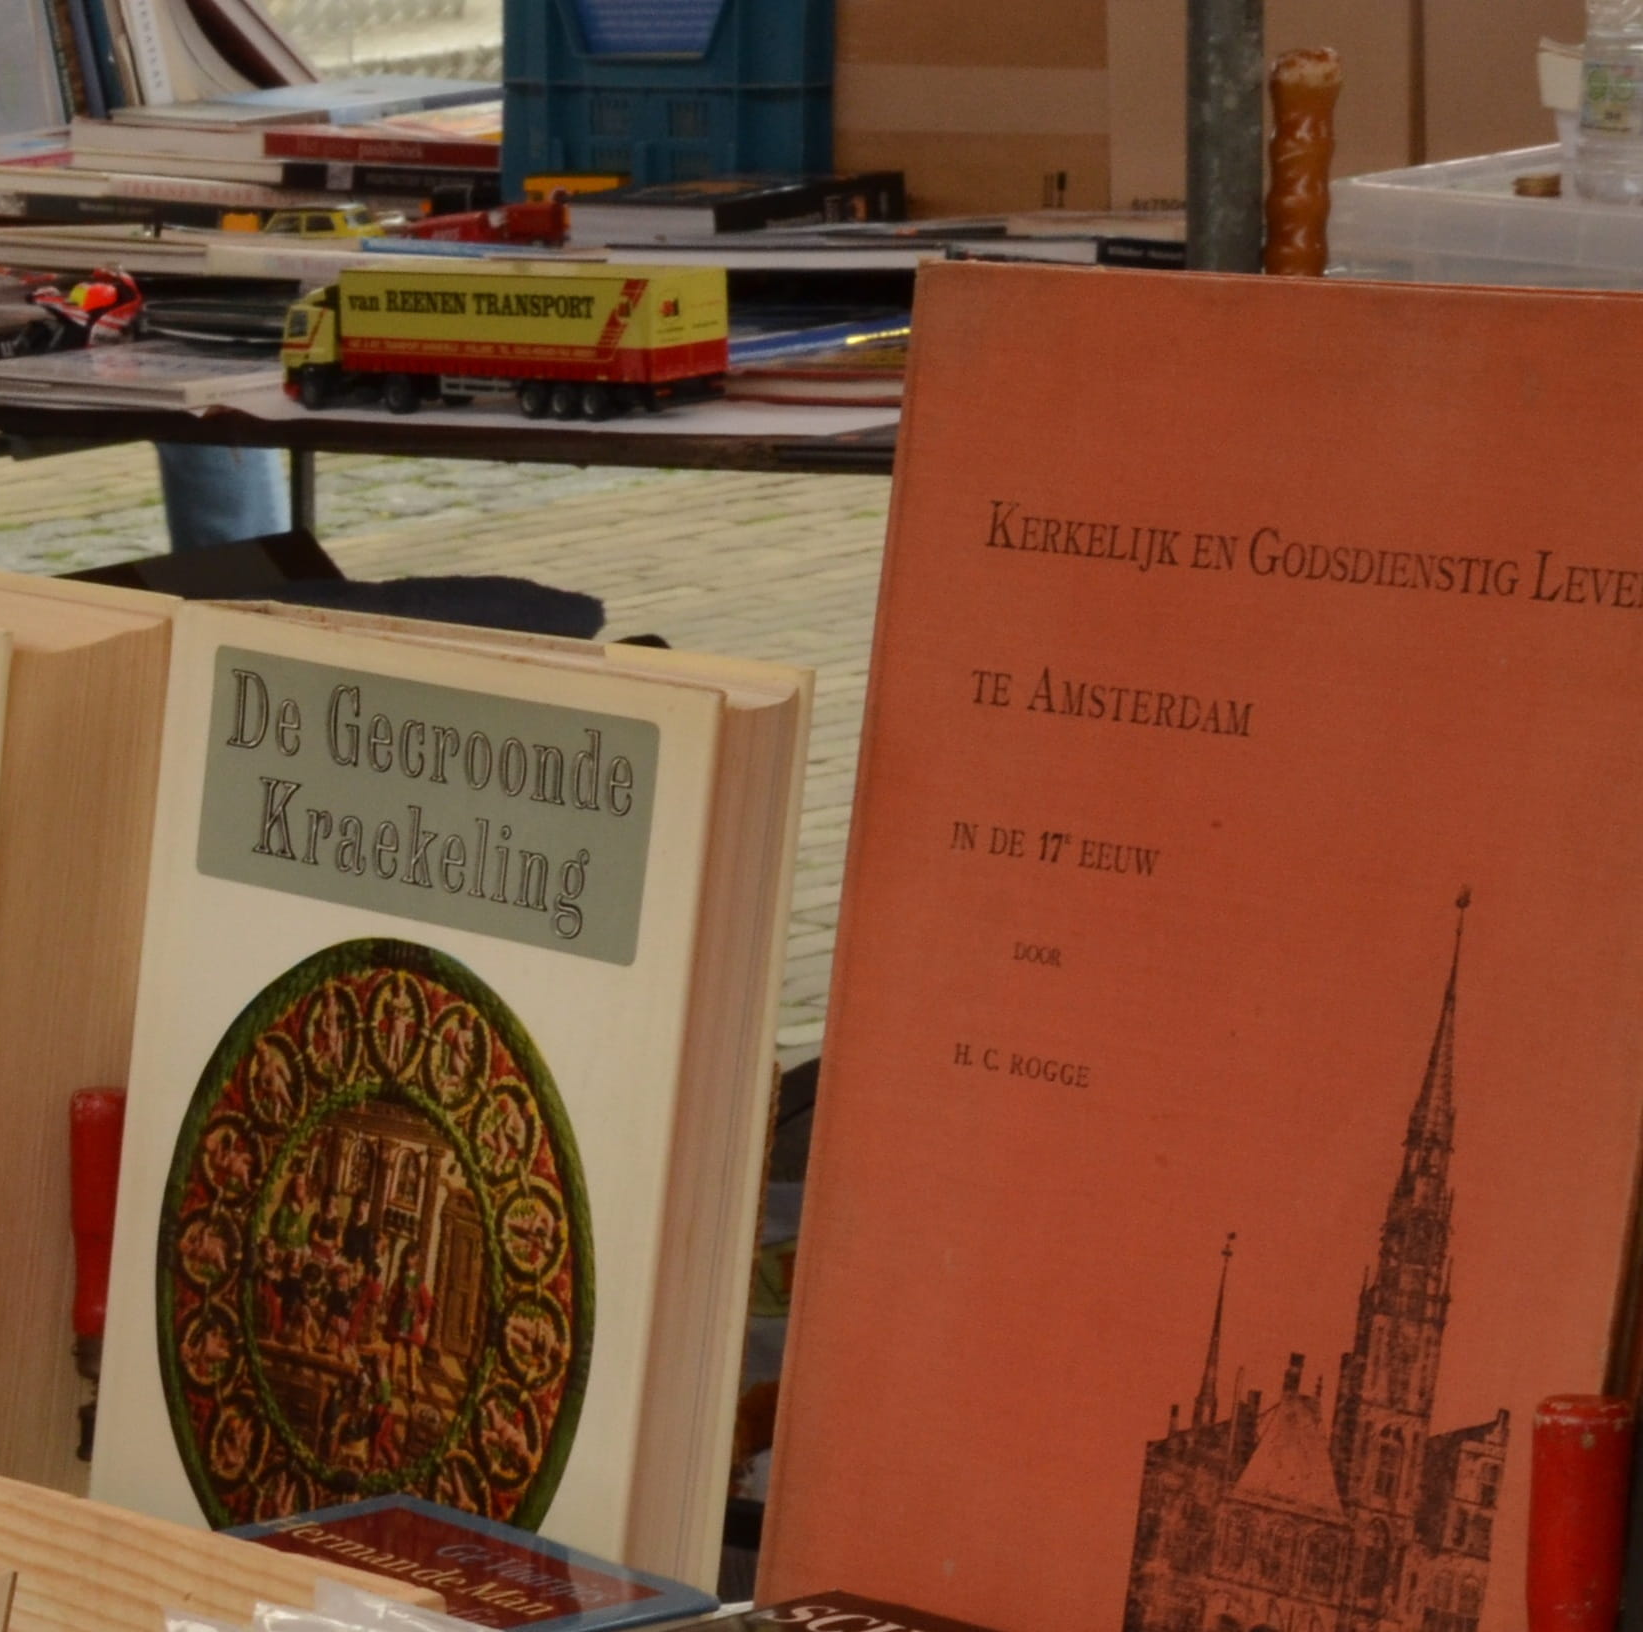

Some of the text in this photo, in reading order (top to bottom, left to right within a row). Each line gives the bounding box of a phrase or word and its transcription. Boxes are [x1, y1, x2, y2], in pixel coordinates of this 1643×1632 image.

[348, 290, 595, 320] van REENEN TRANSPORT
[984, 500, 1180, 572] KERKELIJK
[1191, 529, 1238, 571] EN
[1249, 526, 1518, 596] GODSDIENSTIG
[971, 666, 1255, 736] TE AMSTERDAM
[227, 669, 633, 817] De Gecroonde
[252, 776, 590, 940] Kraekeling
[949, 821, 978, 851] IN
[989, 827, 1024, 860] DE
[1078, 840, 1160, 877] EEUW
[1013, 942, 1062, 968] DOOR
[1009, 1053, 1090, 1088] ROGGE
[414, 1567, 466, 1588] de
[457, 1580, 553, 1616] Man
